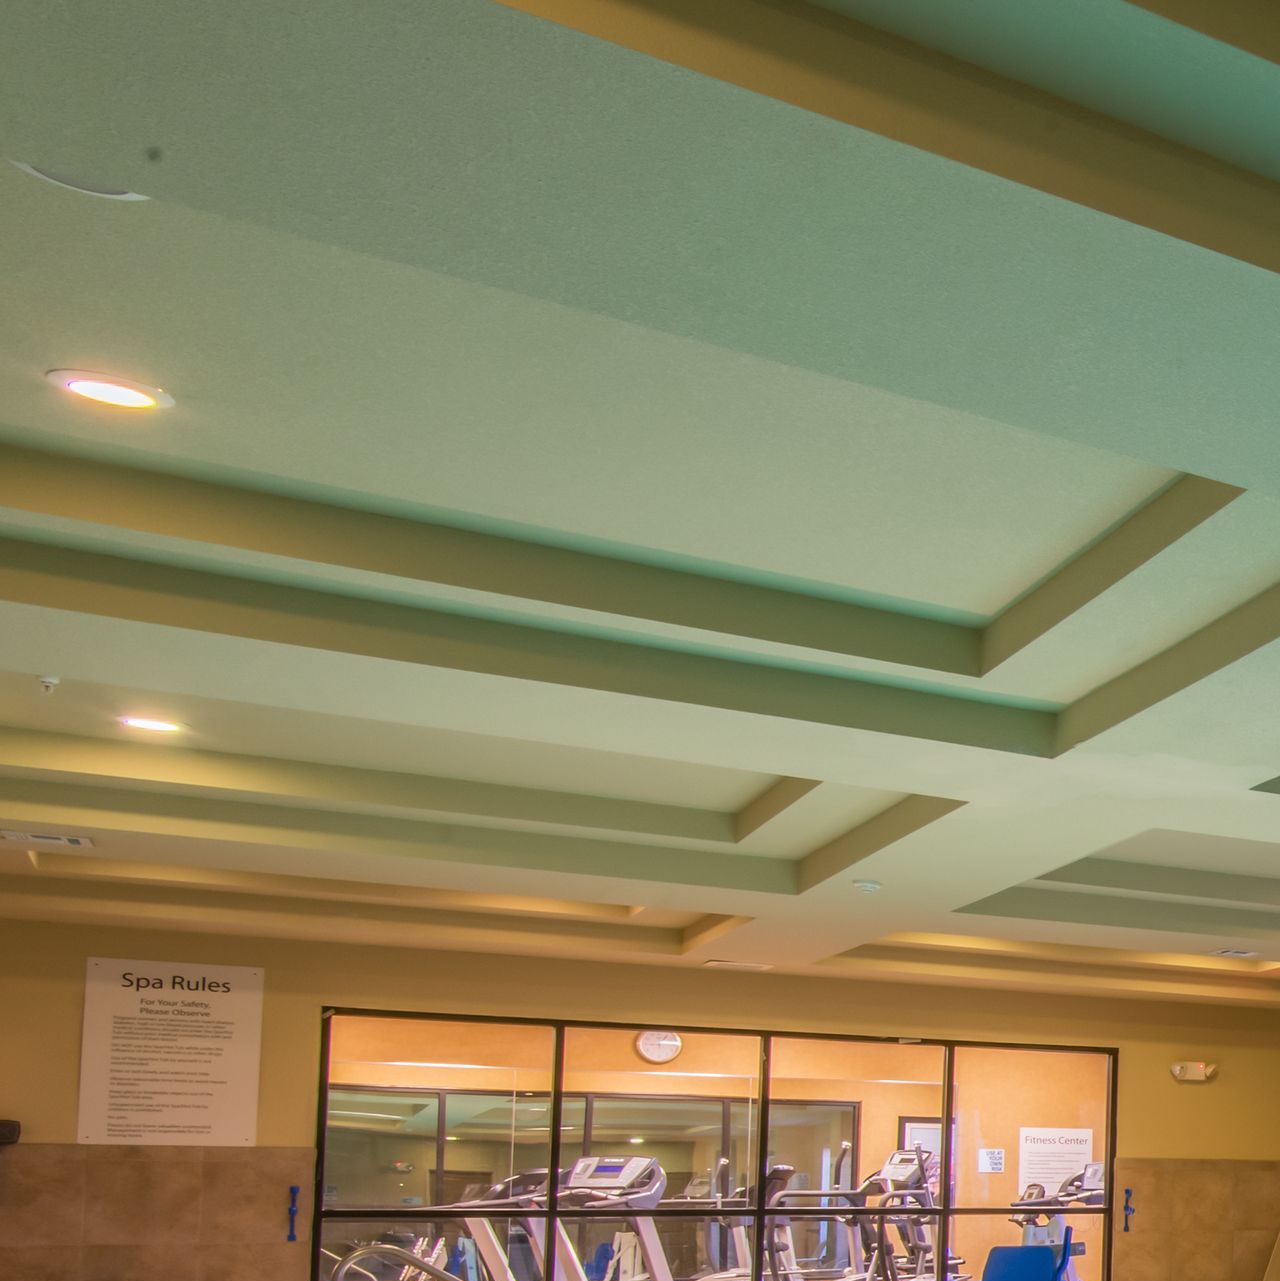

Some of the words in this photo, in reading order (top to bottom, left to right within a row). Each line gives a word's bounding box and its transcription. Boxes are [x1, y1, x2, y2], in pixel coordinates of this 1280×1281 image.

[121, 972, 164, 992] Spa
[171, 975, 232, 993] Rules
[140, 998, 155, 1006] For
[157, 999, 179, 1007] Your
[139, 1007, 170, 1016] Please
[171, 1009, 211, 1017] Observe
[1024, 1135, 1057, 1145] Fitness
[1058, 1136, 1089, 1145] Center
